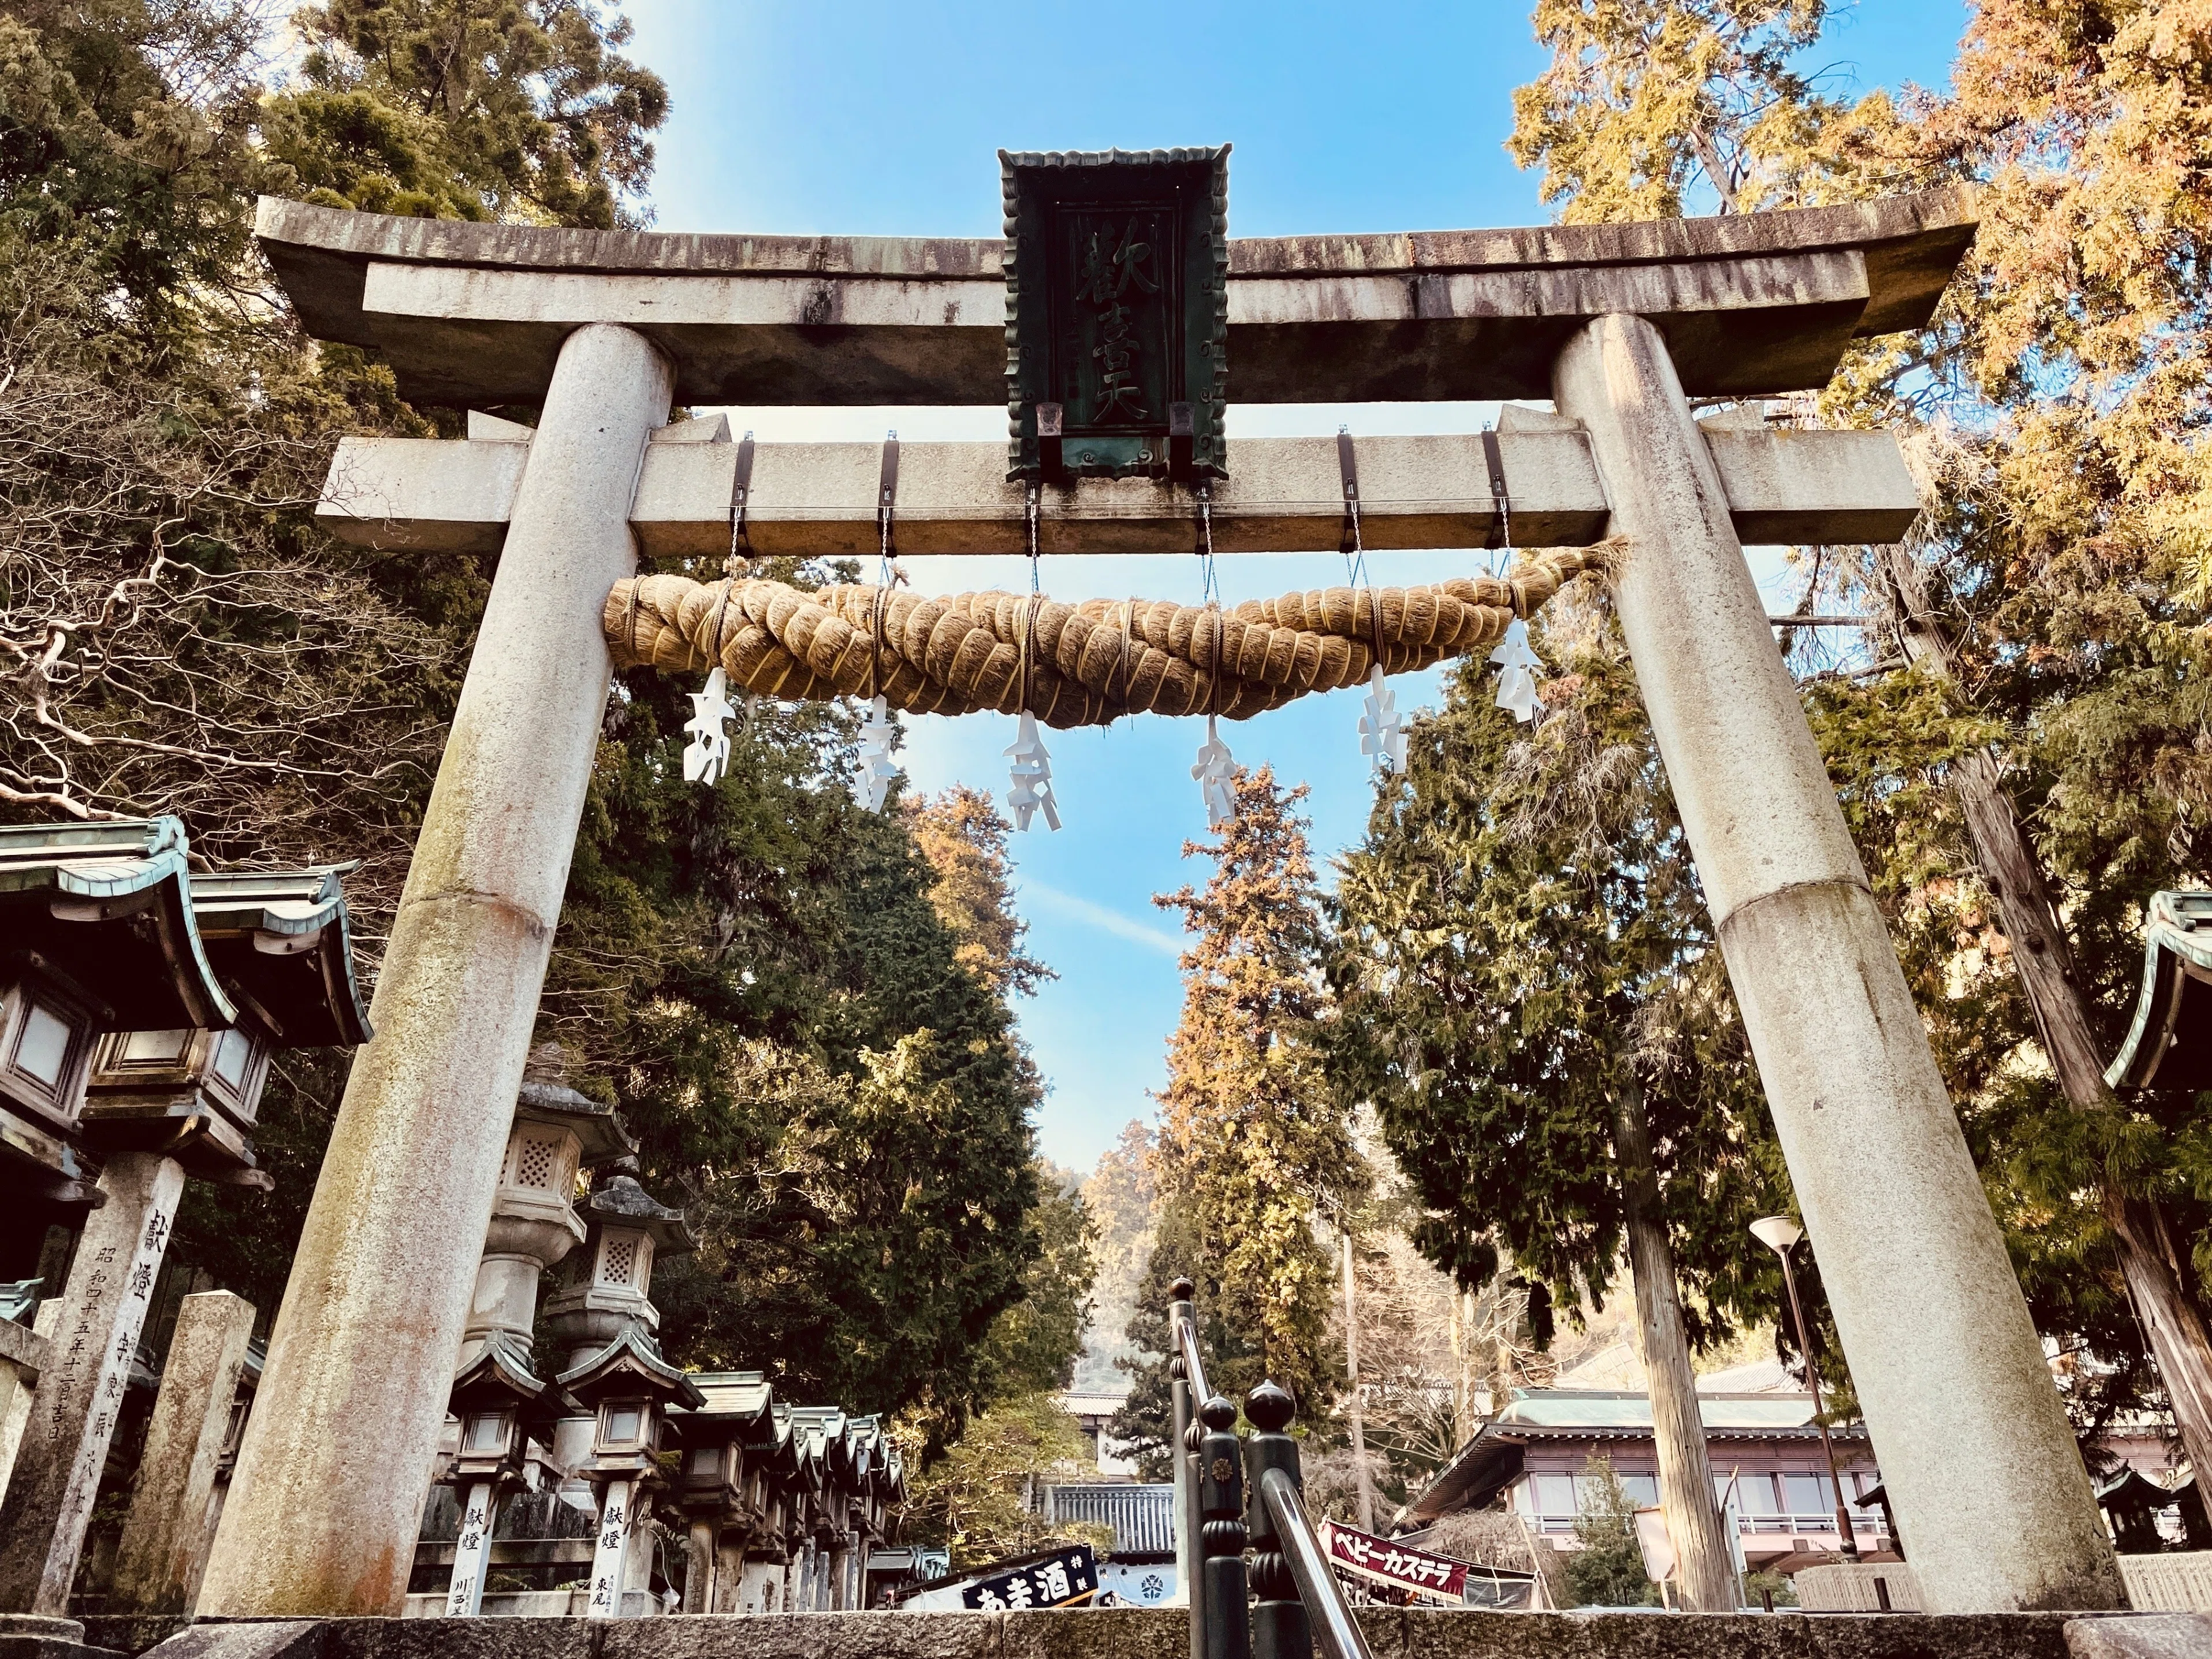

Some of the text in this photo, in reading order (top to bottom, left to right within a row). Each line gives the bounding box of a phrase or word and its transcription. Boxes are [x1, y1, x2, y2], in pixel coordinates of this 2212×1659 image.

[49, 1247, 116, 1439] 昭和四十五年十二月吉日
[977, 1561, 1071, 1610] あま酒
[1335, 1532, 1453, 1586] ベビーカステラ
